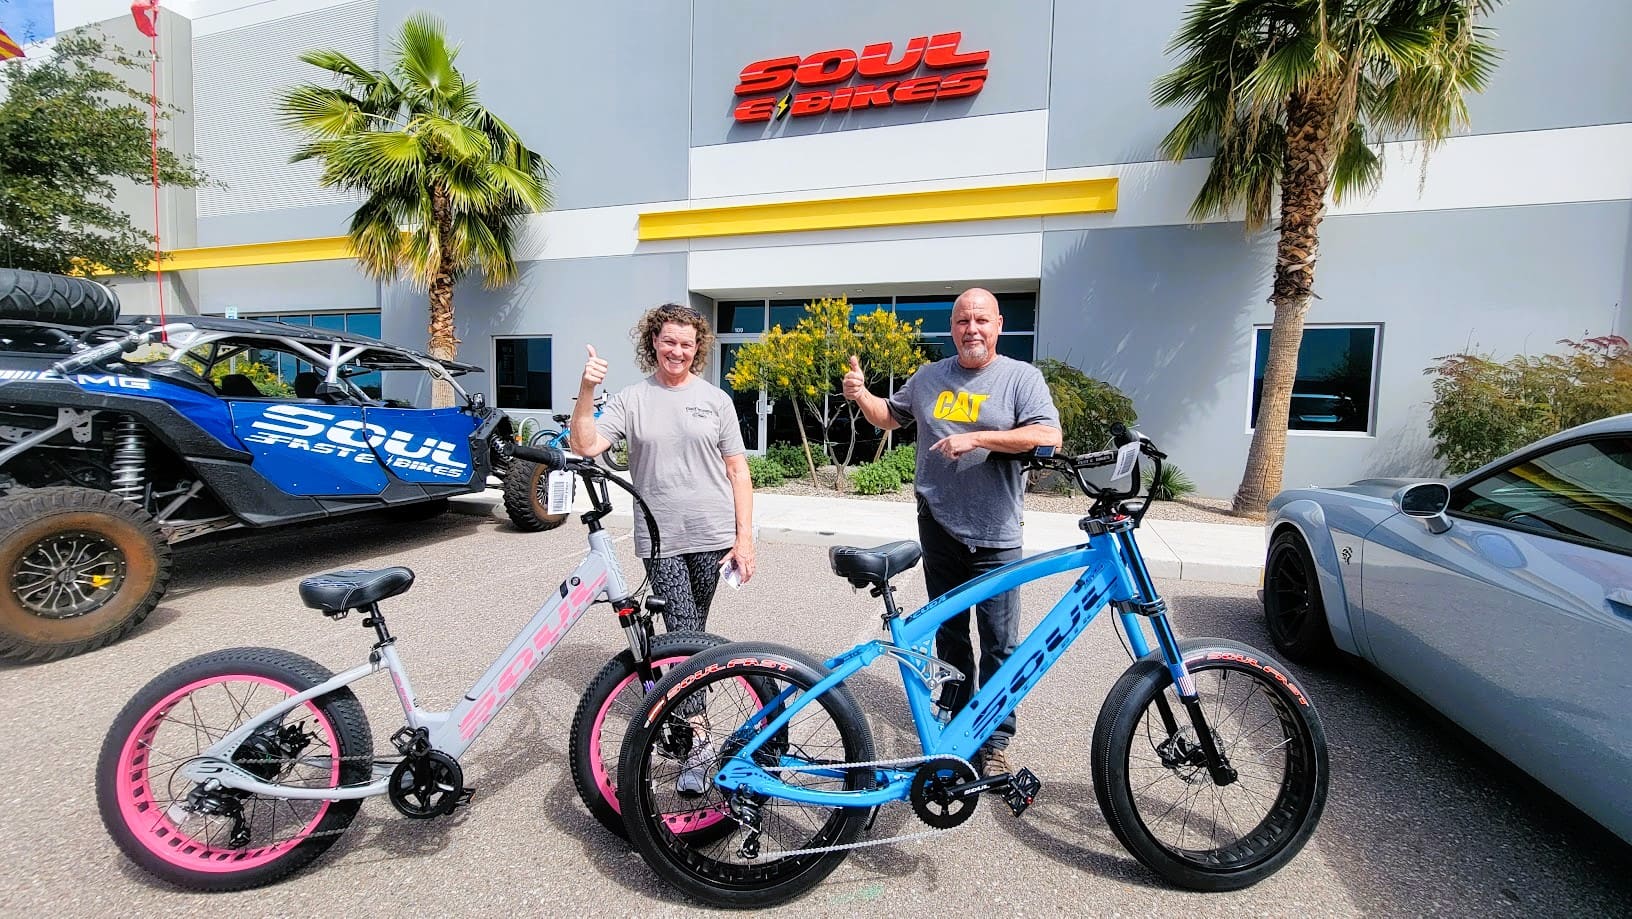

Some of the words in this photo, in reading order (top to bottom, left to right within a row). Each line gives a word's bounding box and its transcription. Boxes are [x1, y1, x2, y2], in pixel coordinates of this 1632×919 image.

[734, 32, 989, 96] SOUL
[791, 69, 988, 116] BIKES
[933, 390, 988, 423] CAT
[244, 431, 356, 458] FAST
[393, 458, 463, 478] BIKES
[251, 405, 467, 469] SOUL
[459, 569, 607, 741] SOUL
[667, 663, 726, 700] SOUL
[726, 657, 793, 671] FAST
[972, 576, 1117, 740] SOUL
[1207, 651, 1263, 670] SOUL
[1262, 665, 1310, 707] FAST
[964, 784, 990, 795] SOUL
